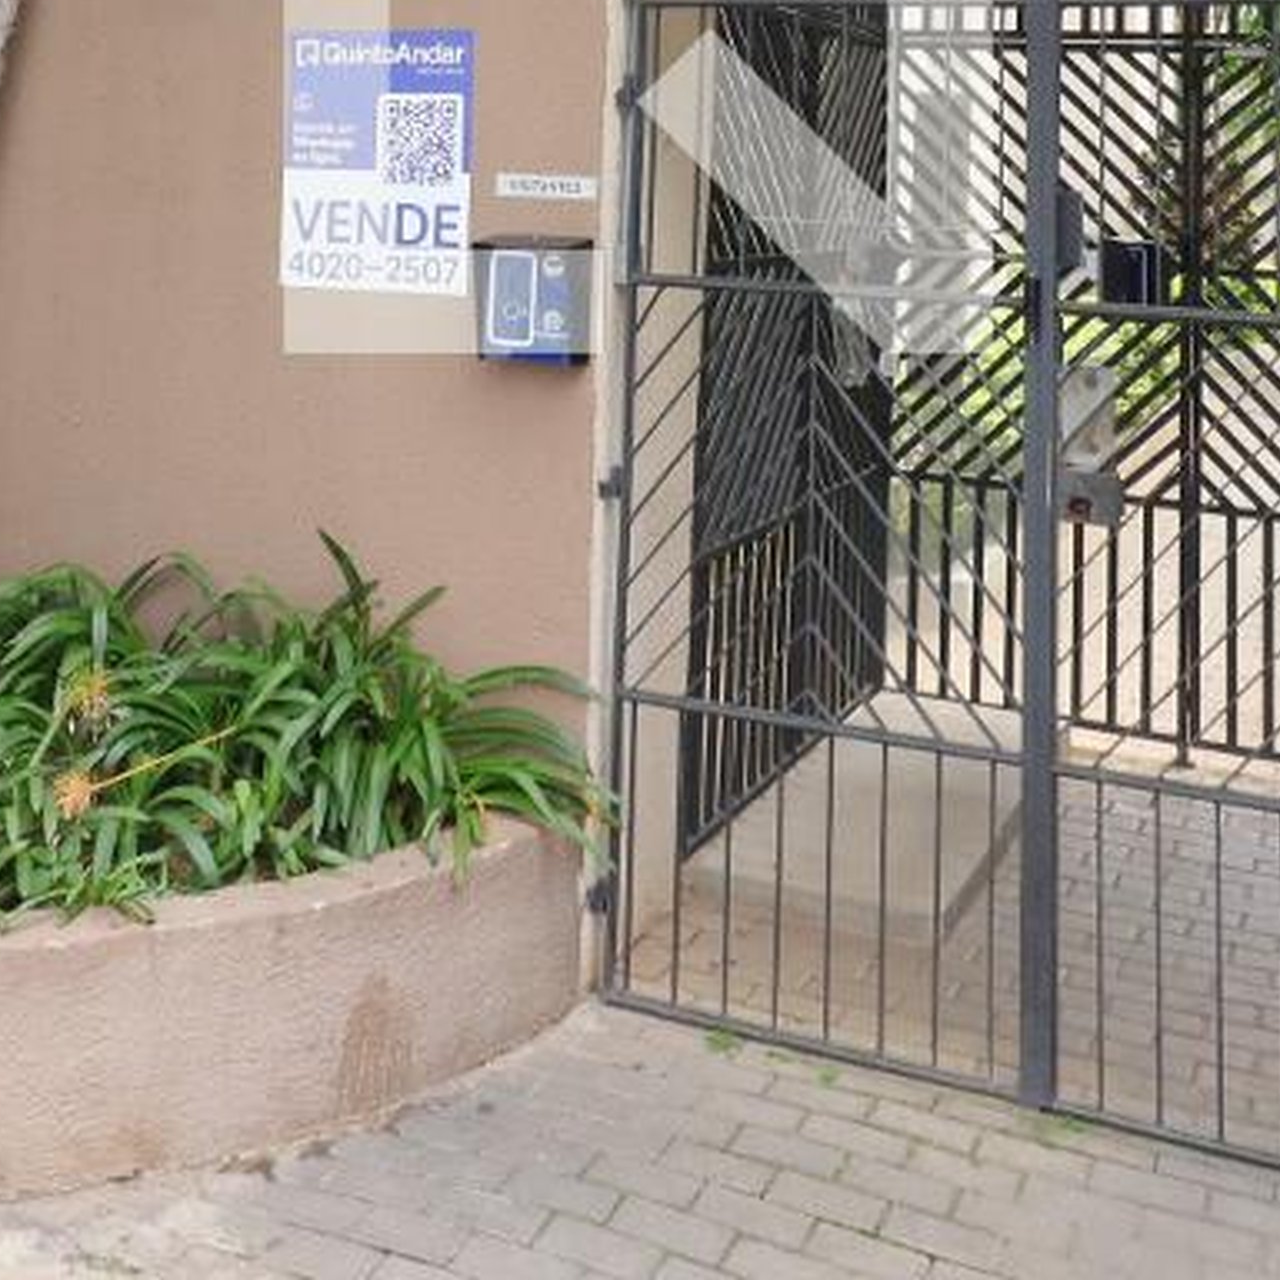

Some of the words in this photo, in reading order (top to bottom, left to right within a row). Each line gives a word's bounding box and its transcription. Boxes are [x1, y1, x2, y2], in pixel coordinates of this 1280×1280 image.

[322, 40, 465, 65] QuintoAndar
[293, 199, 462, 249] VENDE
[289, 250, 460, 286] 4020-2507
